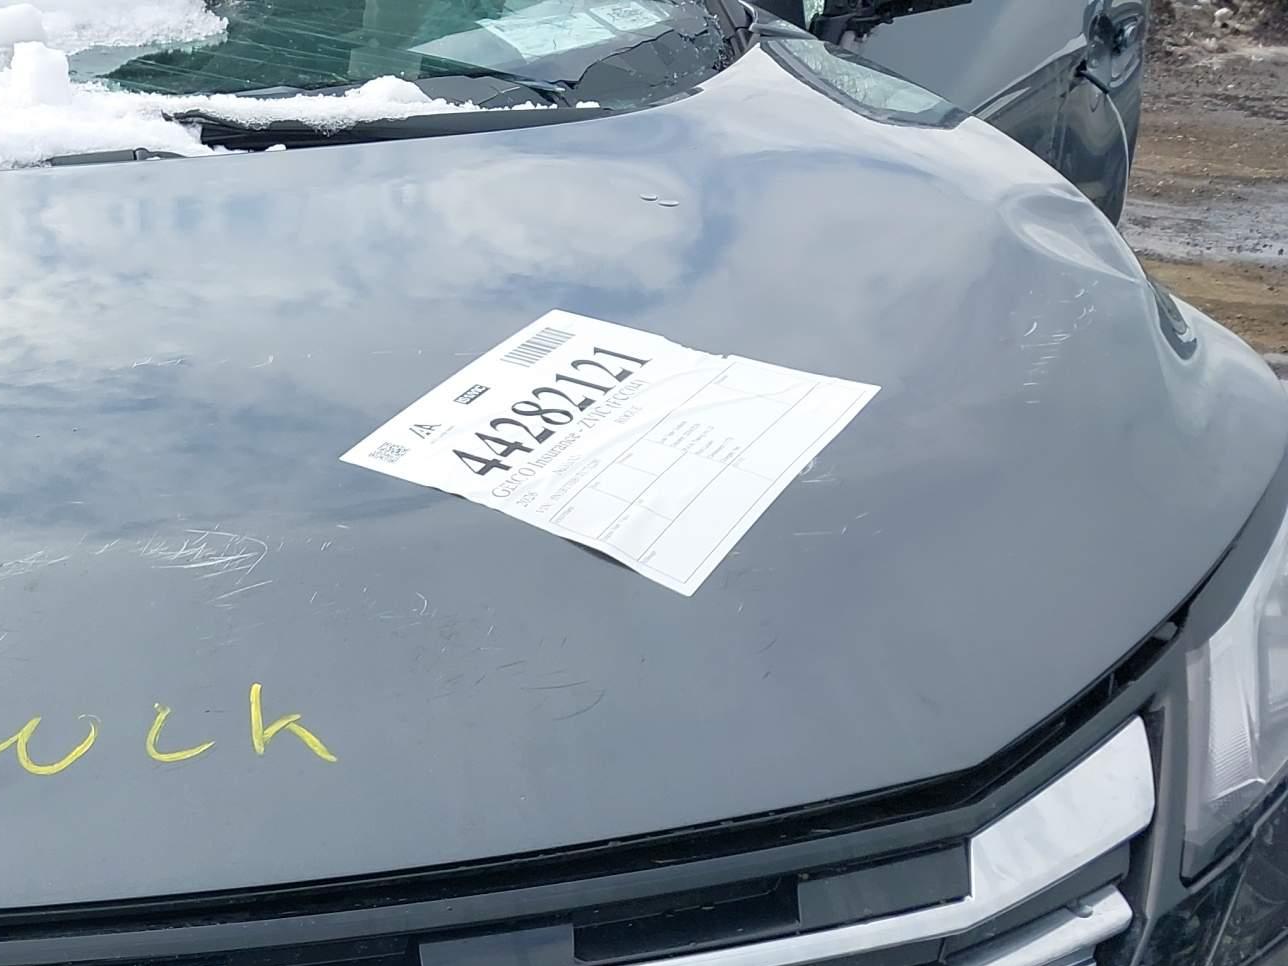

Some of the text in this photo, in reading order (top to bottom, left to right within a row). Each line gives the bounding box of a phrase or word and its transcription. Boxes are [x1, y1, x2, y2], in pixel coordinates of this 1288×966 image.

[452, 347, 653, 477] 44282121
[491, 467, 537, 498] GEICO
[527, 432, 581, 469] Insurance
